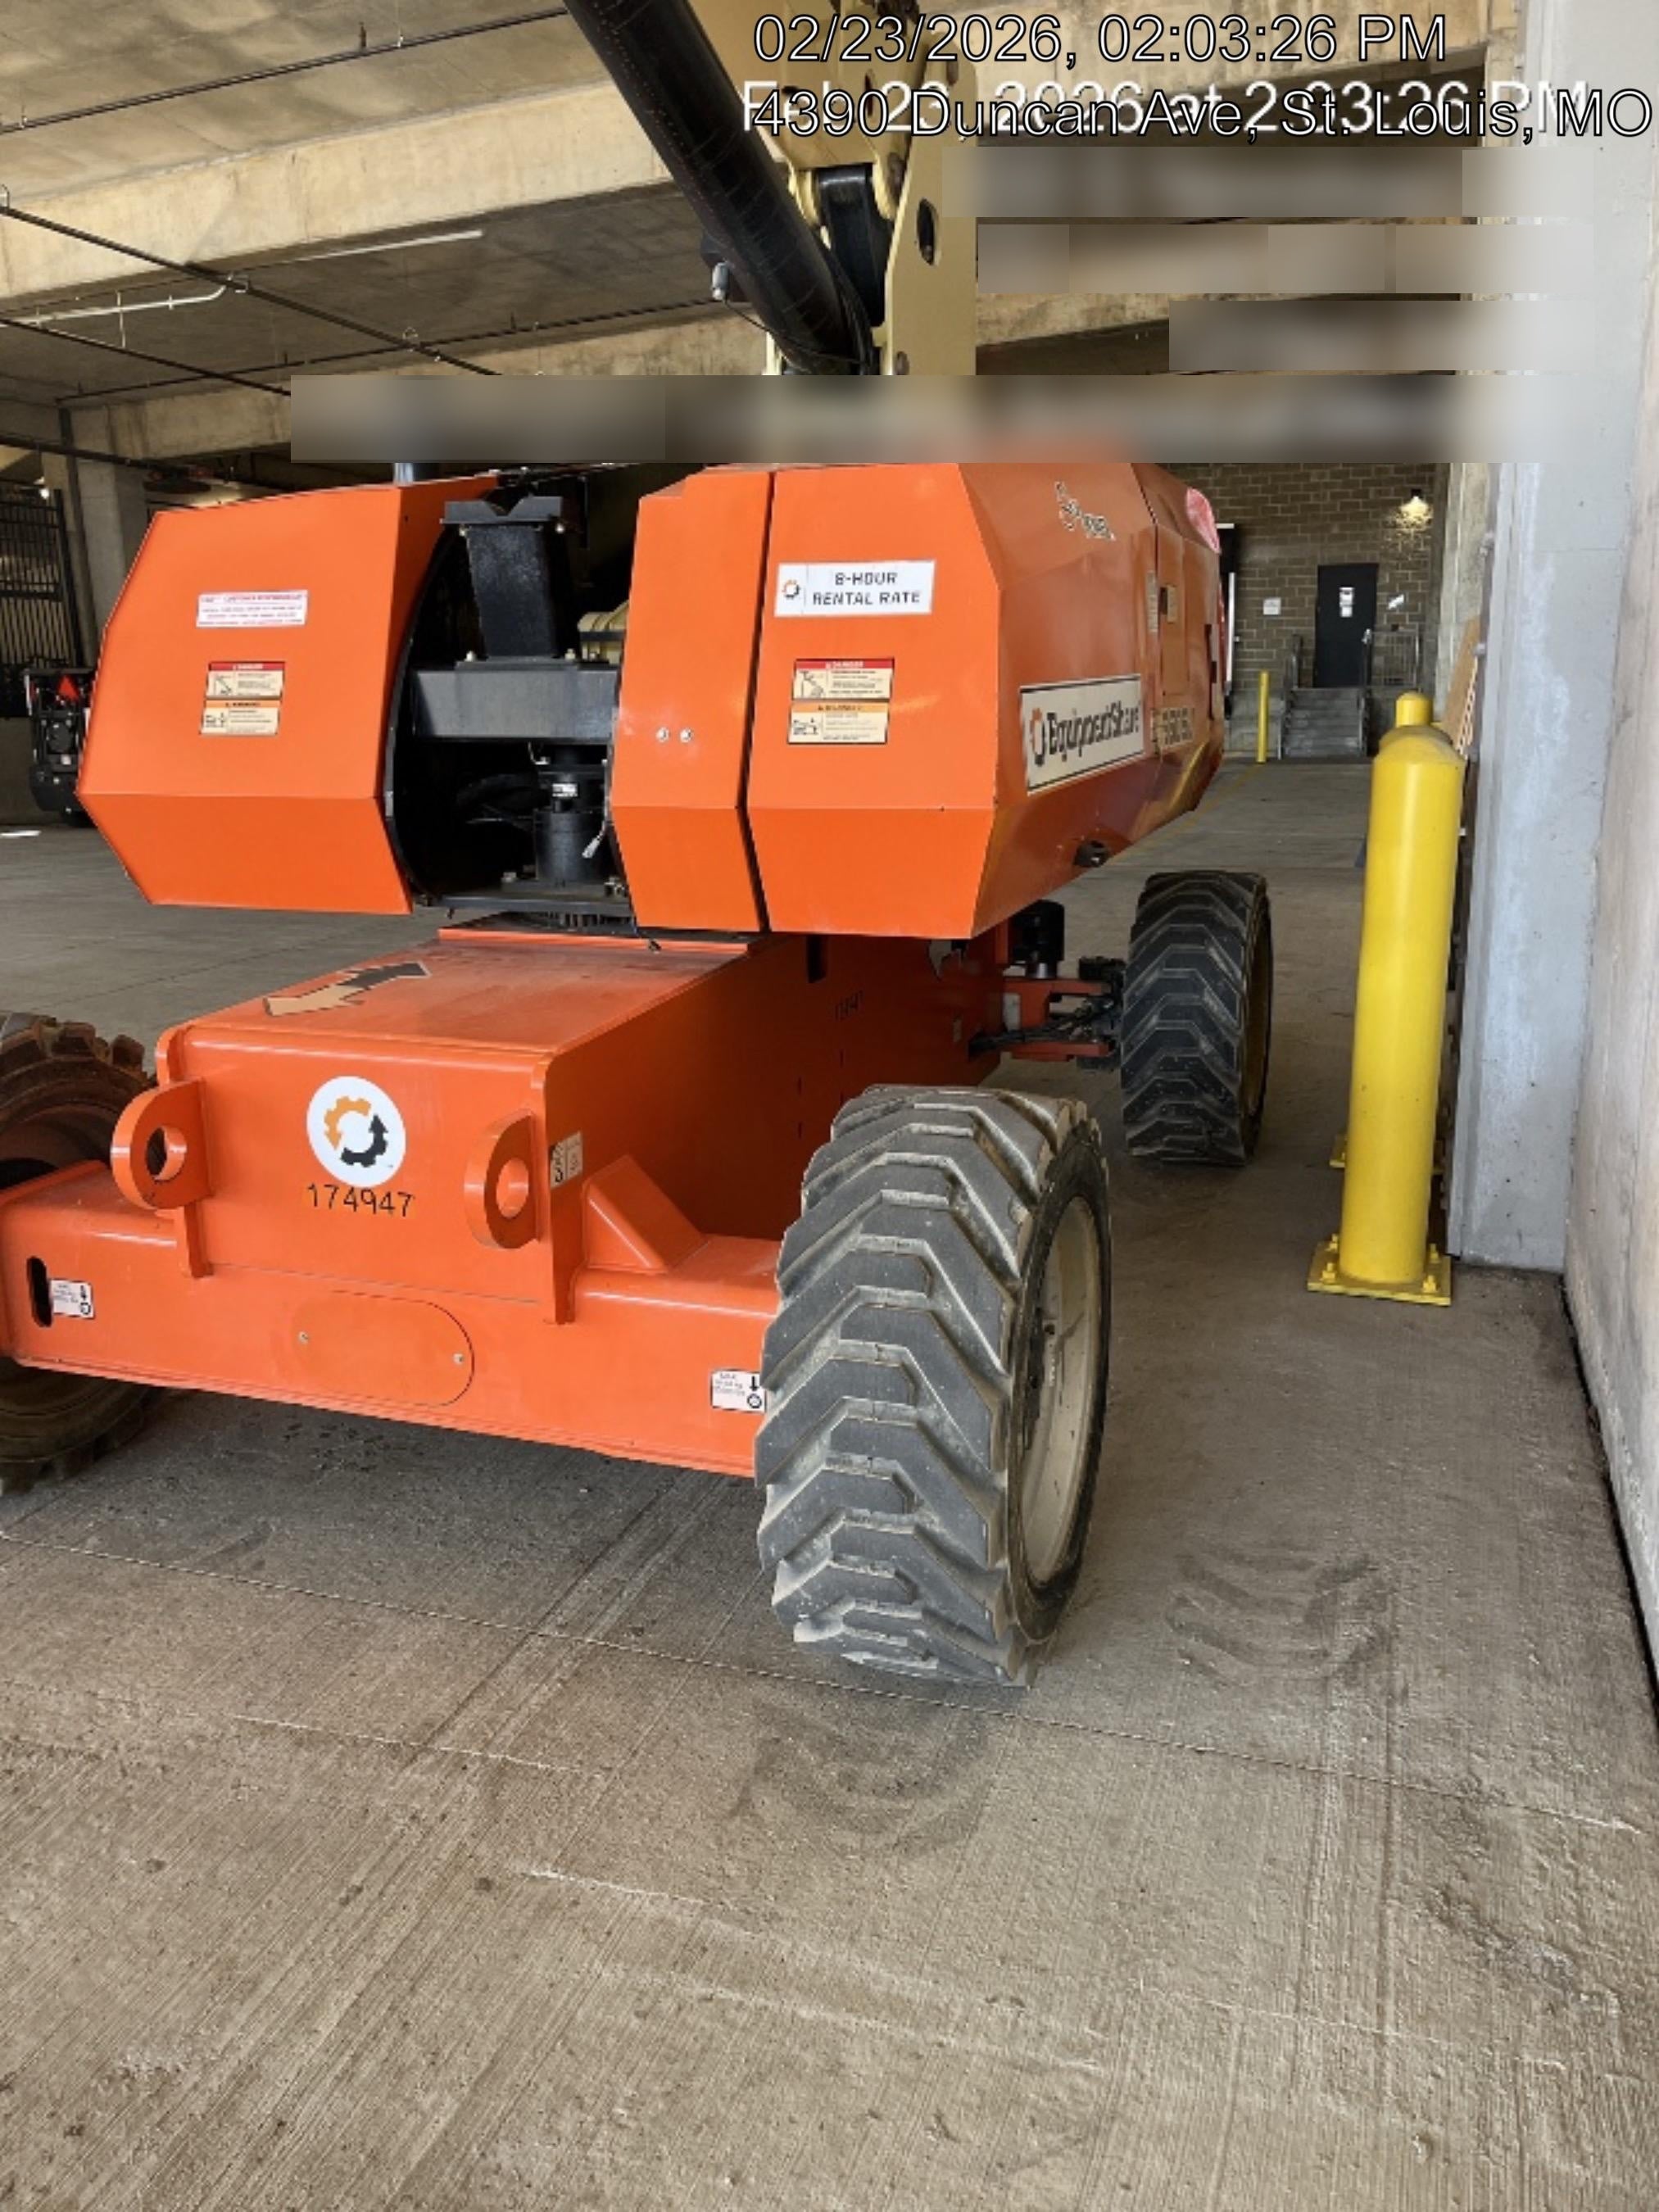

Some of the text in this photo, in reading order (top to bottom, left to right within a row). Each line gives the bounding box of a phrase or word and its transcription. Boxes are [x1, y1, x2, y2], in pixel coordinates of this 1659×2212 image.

[834, 571, 898, 587] 8-HOUR
[812, 590, 921, 606] RENTAL RATE
[307, 1182, 416, 1217] 174947
